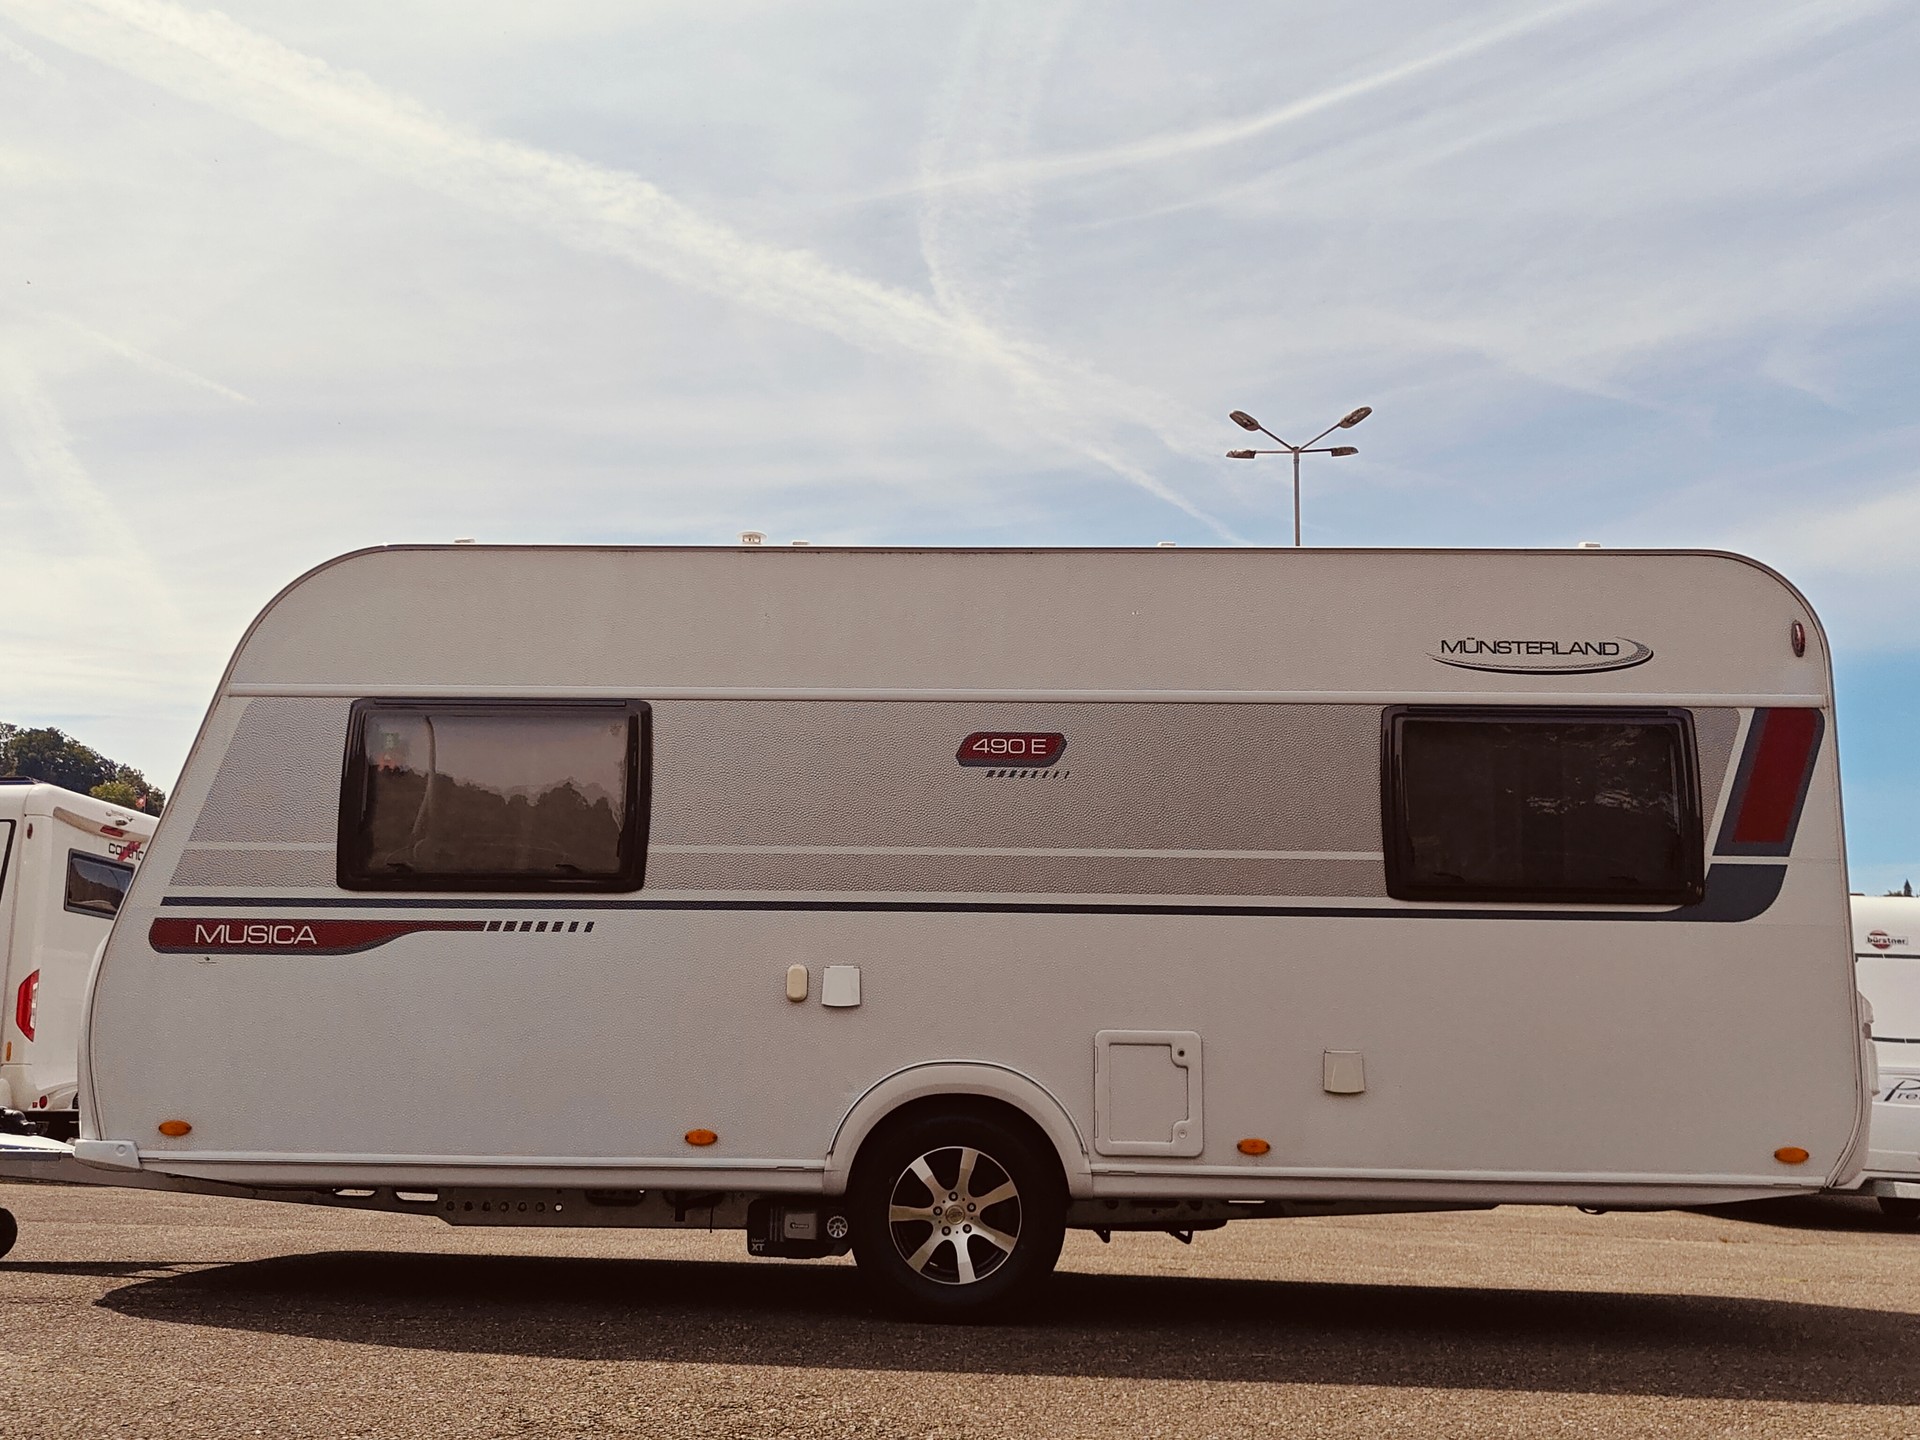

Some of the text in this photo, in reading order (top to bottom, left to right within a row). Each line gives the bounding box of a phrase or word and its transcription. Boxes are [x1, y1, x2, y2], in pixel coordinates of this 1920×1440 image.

[1441, 637, 1620, 656] MÜNSTERLAND
[972, 738, 1047, 755] 490 E
[195, 924, 317, 945] MUSICA
[751, 1243, 765, 1252] XT
